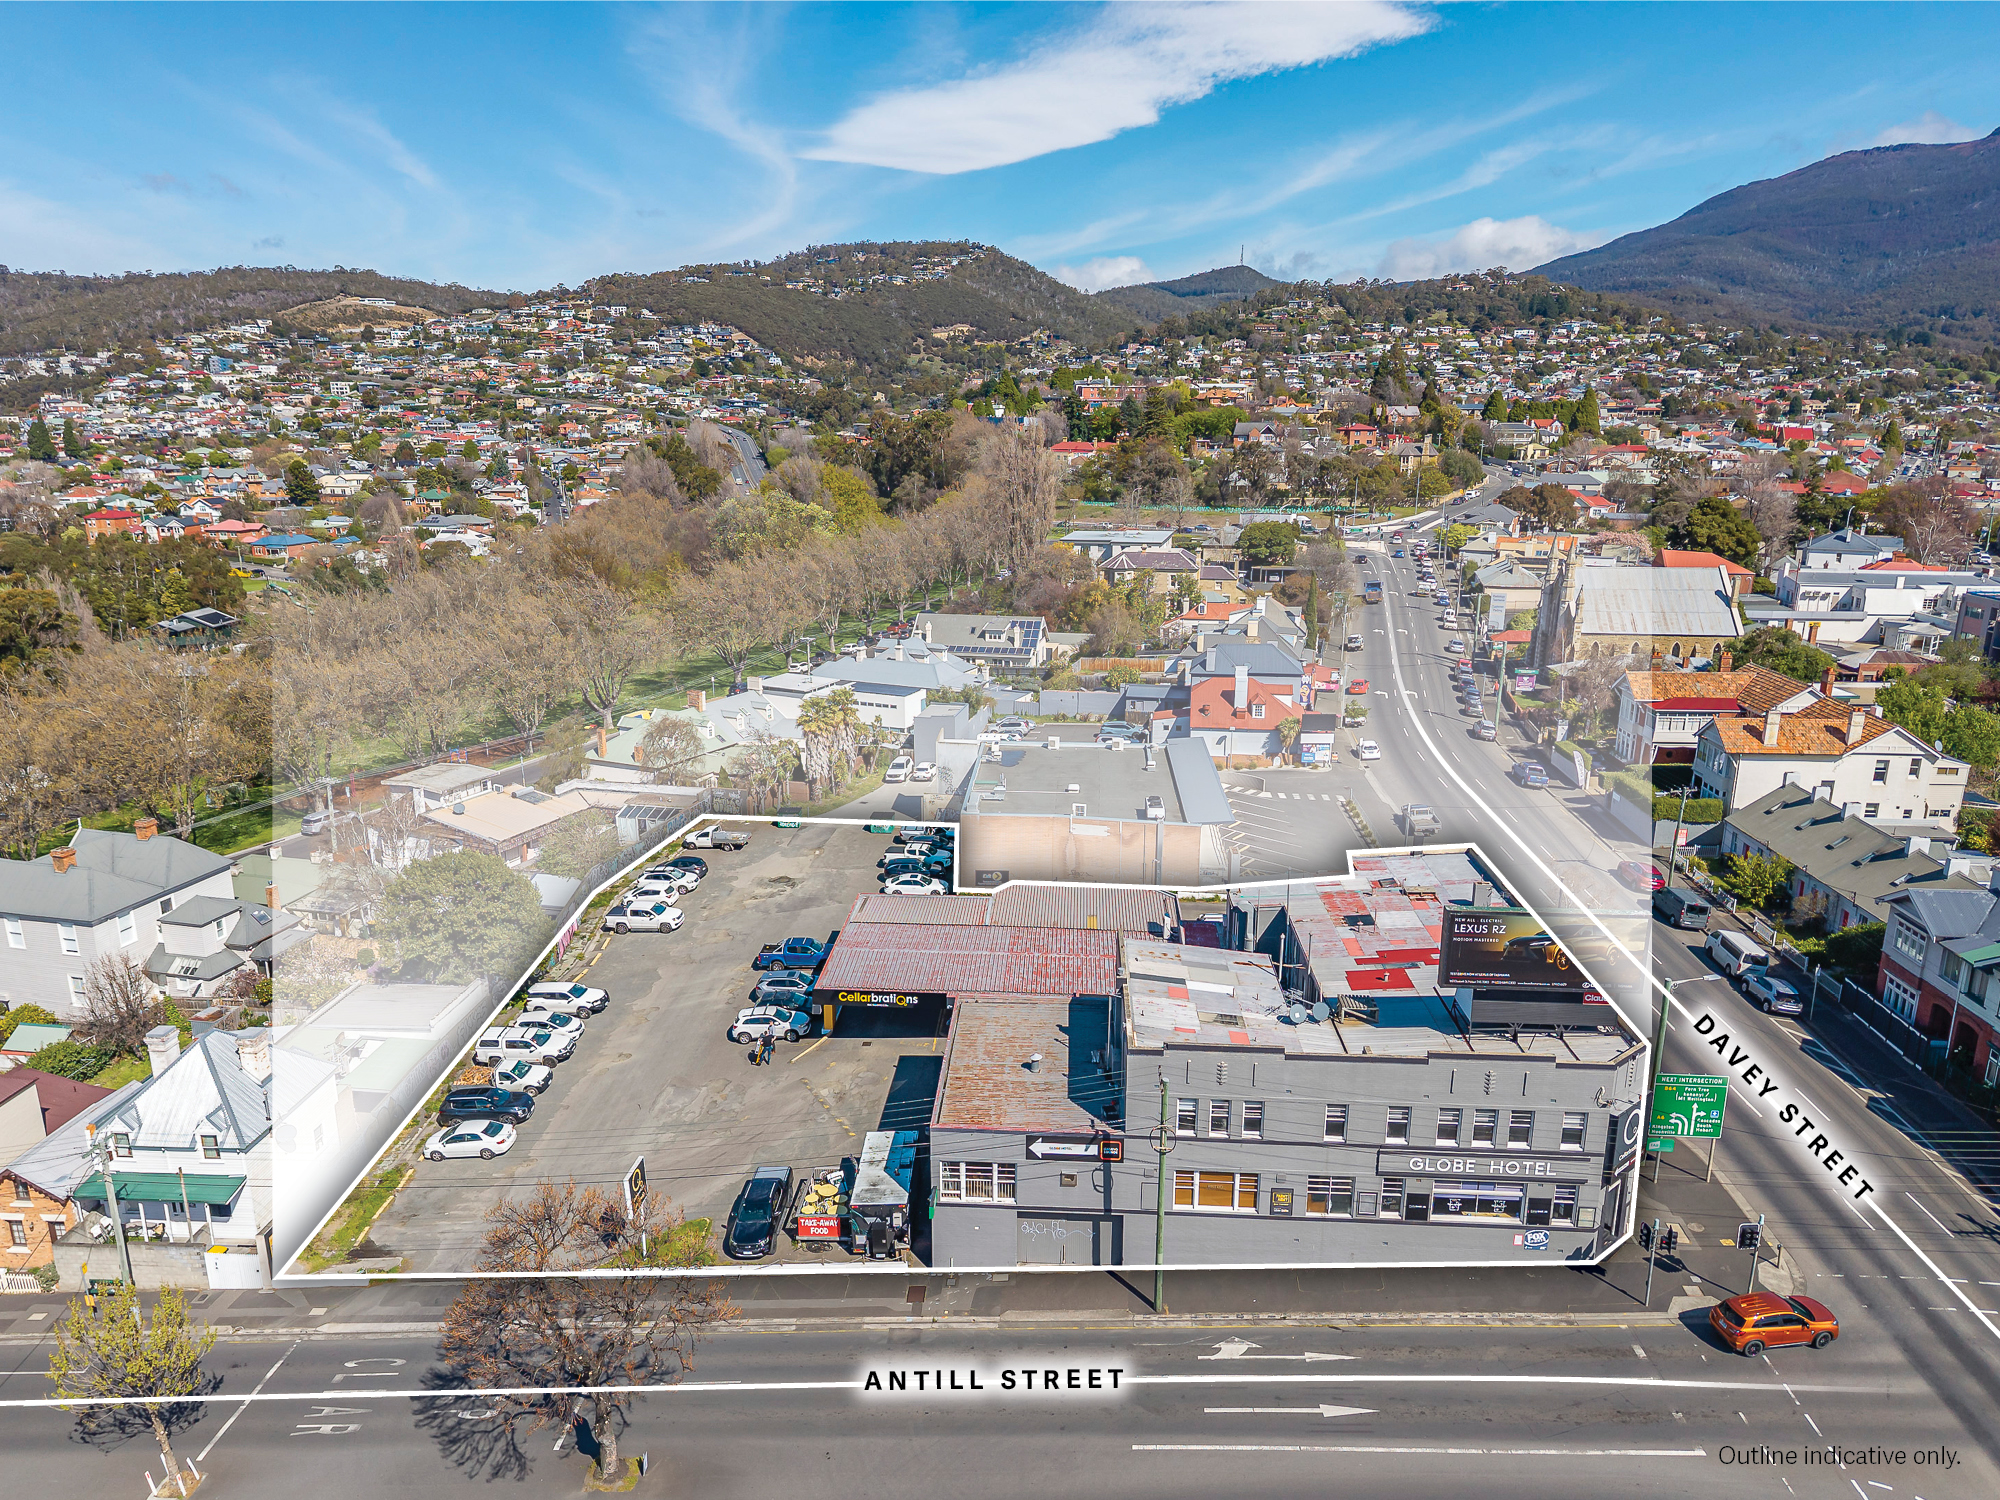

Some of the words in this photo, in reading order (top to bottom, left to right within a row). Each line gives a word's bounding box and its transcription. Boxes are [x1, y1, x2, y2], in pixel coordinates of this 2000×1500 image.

[1454, 924, 1488, 934] LEXUS
[1492, 925, 1506, 934] RZ
[838, 992, 918, 1006] Cellarbrations
[1409, 1157, 1476, 1173] GLOBE
[1489, 1160, 1557, 1176] HOTEL
[800, 1219, 838, 1227] TAKE-AWAY
[810, 1227, 829, 1235] FOOD
[1527, 1232, 1546, 1243] FOX
